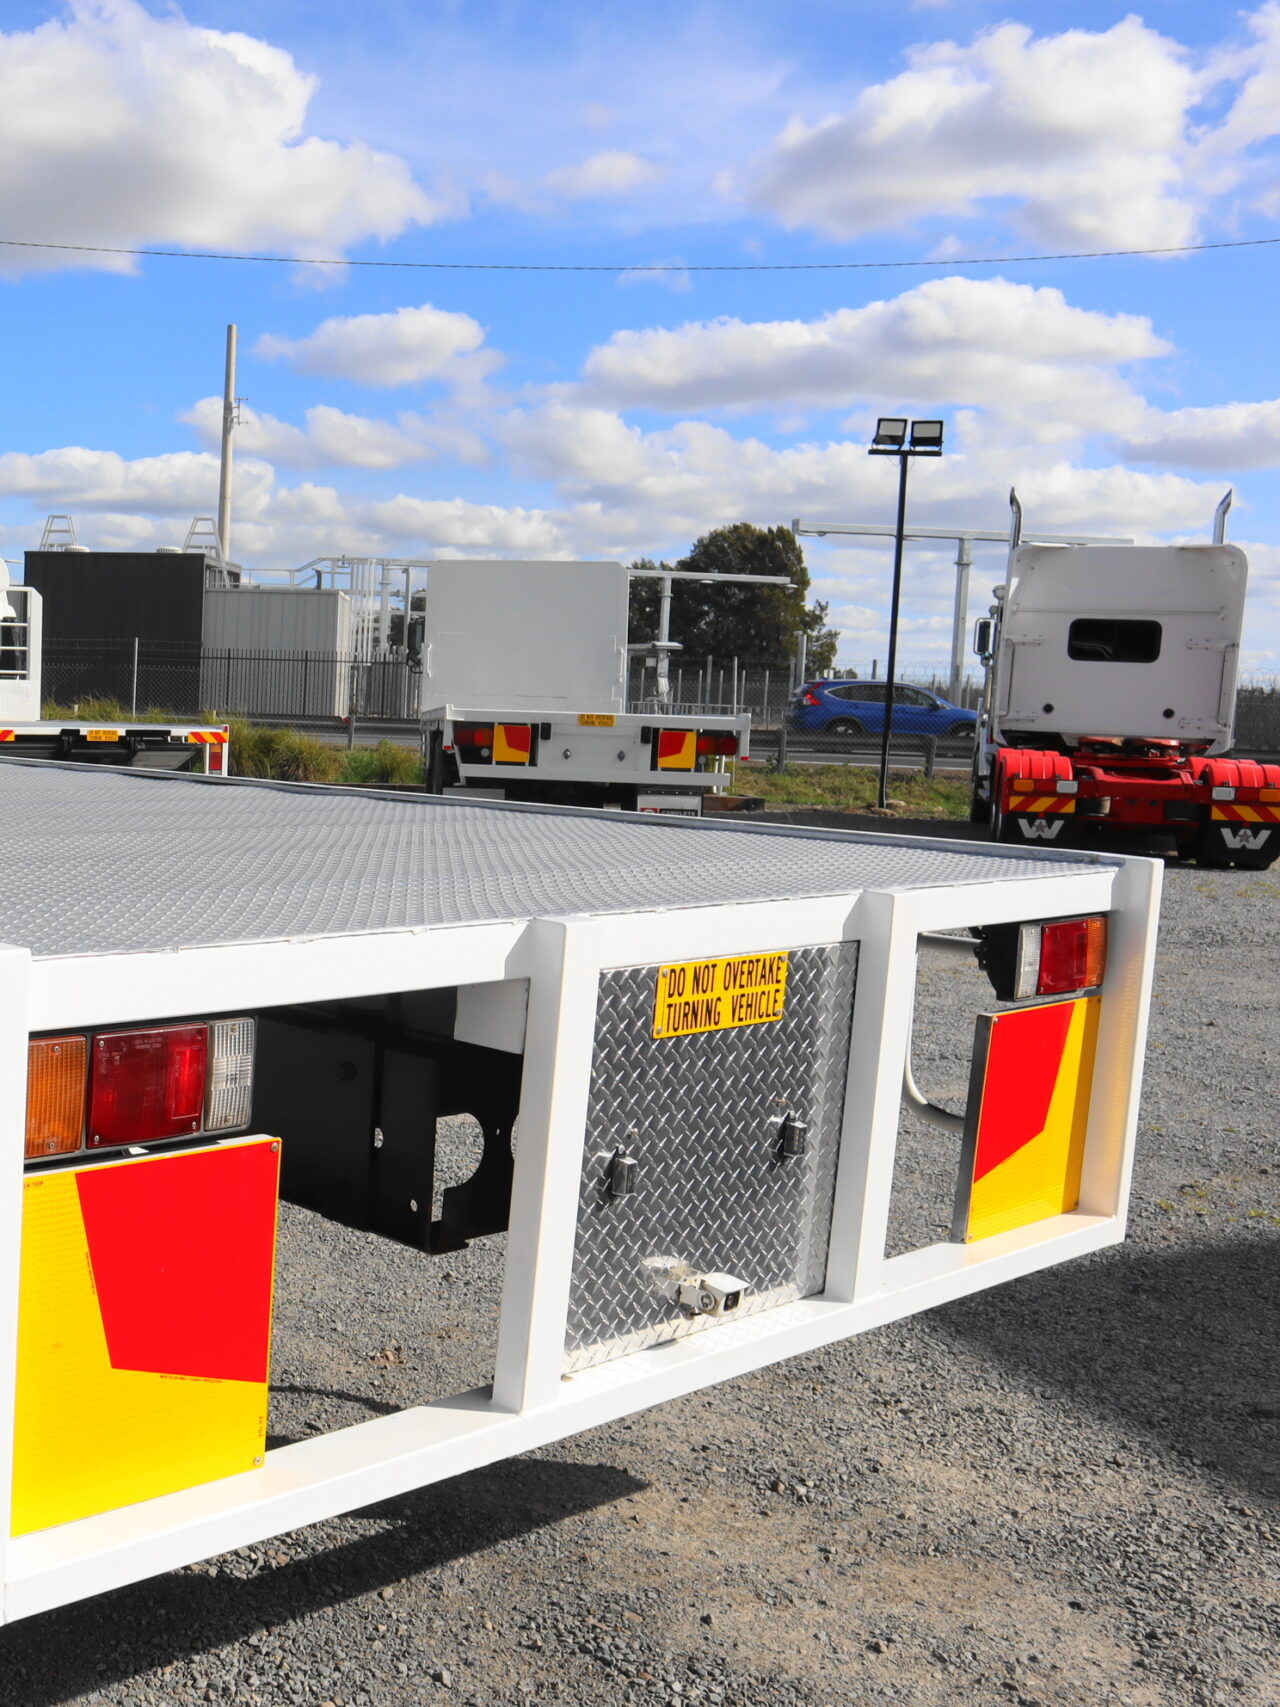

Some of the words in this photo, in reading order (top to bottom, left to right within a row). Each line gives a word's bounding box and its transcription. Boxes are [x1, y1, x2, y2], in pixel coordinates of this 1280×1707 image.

[668, 967, 686, 998] DO
[692, 963, 718, 995] NOT
[723, 956, 782, 991] OVERTAKE
[666, 996, 722, 1033] TURNING
[731, 989, 781, 1023] VEHICLE
